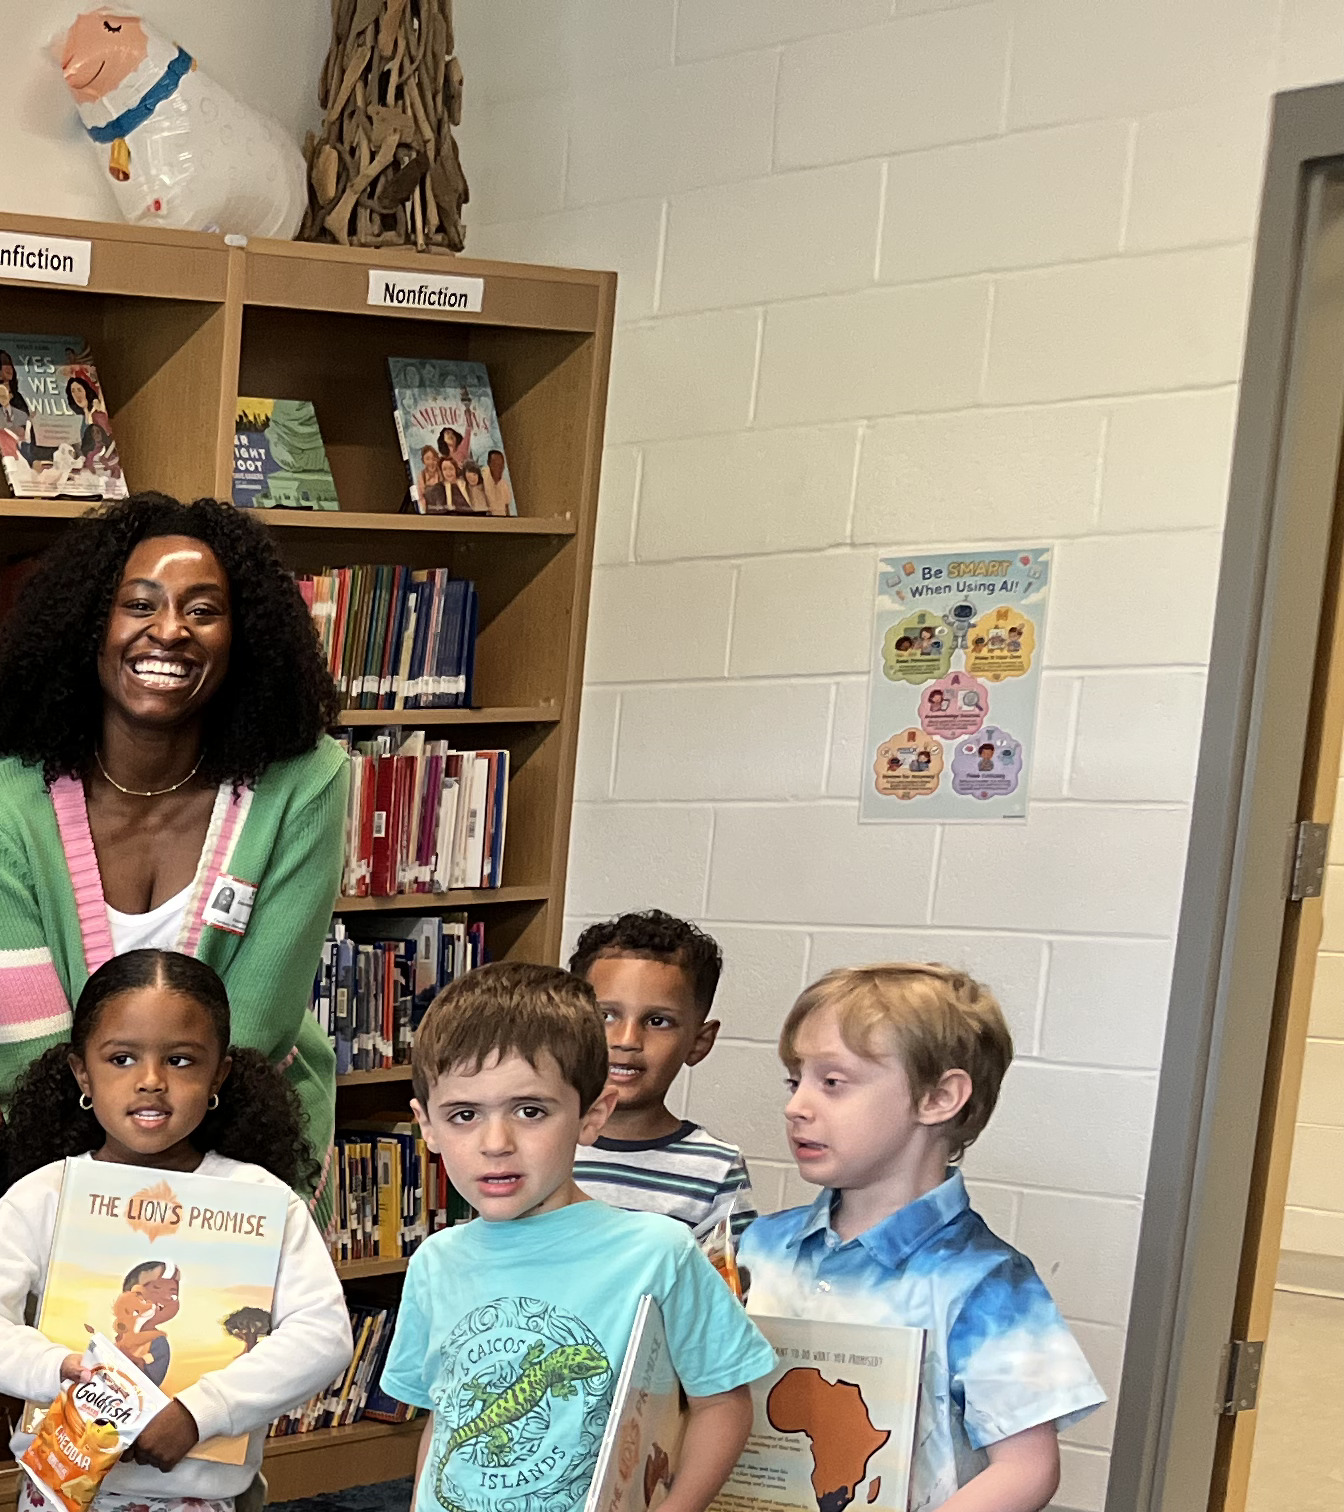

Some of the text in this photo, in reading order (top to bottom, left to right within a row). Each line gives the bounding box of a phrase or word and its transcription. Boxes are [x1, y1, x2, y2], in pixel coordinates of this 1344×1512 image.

[382, 282, 468, 310] Nonfiction
[19, 355, 55, 373] YES
[28, 377, 59, 394] WE
[25, 397, 75, 415] WILL
[922, 561, 1012, 580] Be SMART
[910, 583, 952, 599] When
[956, 581, 996, 594] Using
[89, 1193, 267, 1237] THE LION'S PROMISE
[467, 1336, 526, 1364] CAICOS
[76, 1382, 133, 1424] Goldfish
[55, 1425, 91, 1471] CHEDDAR
[479, 1445, 566, 1490] ISLANDS
